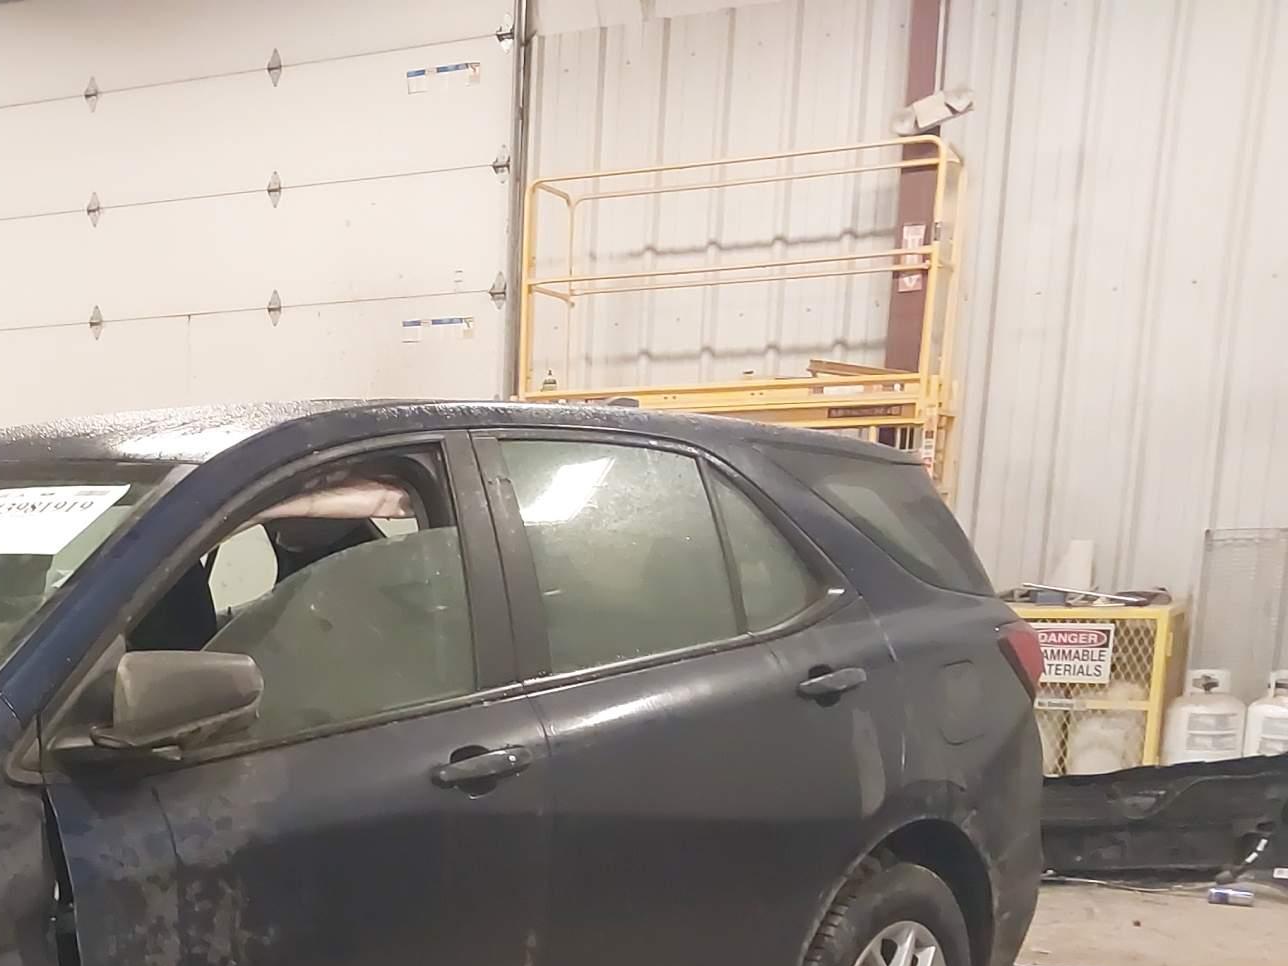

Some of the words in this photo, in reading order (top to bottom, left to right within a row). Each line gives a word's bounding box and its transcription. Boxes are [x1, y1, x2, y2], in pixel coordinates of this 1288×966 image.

[1038, 632, 1098, 644] DANGER
[1043, 649, 1106, 662] AMMABLE
[1043, 663, 1102, 677] TERIALS
